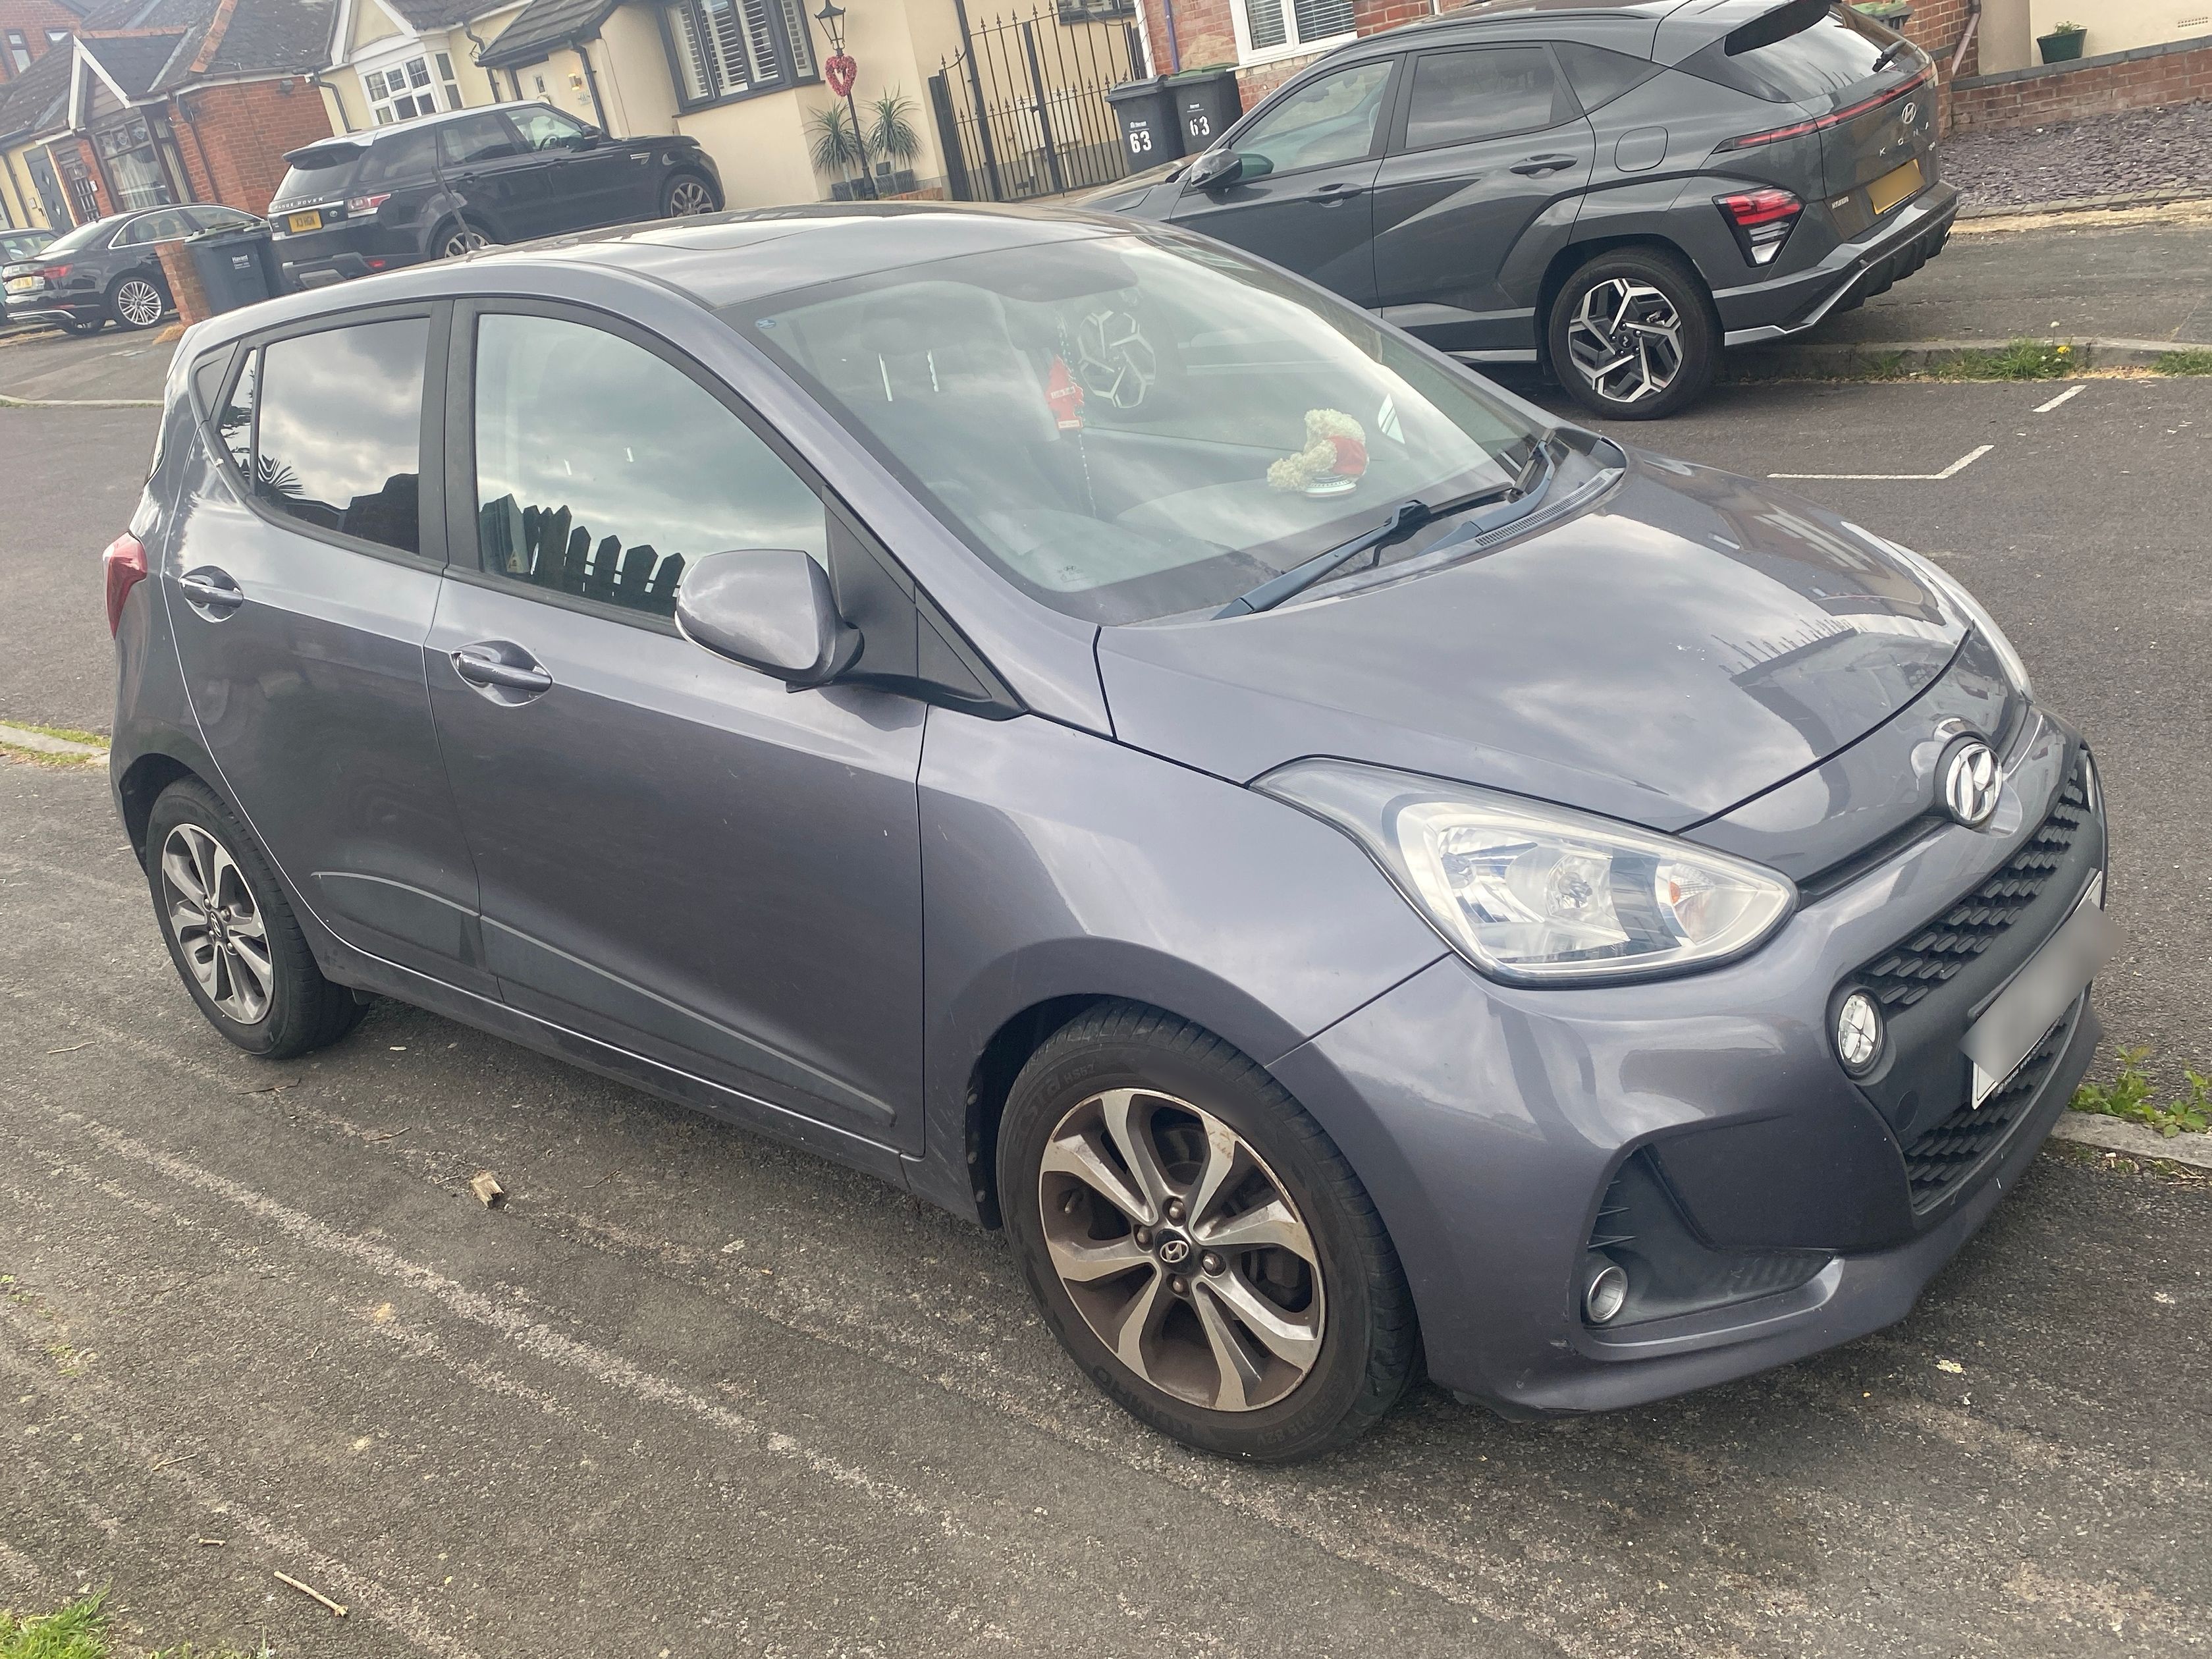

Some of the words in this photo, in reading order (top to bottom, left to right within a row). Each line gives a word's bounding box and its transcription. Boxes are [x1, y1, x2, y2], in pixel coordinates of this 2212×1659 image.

[1189, 116, 1210, 136] 63
[1129, 131, 1152, 153] 63
[298, 197, 323, 205] ROVER
